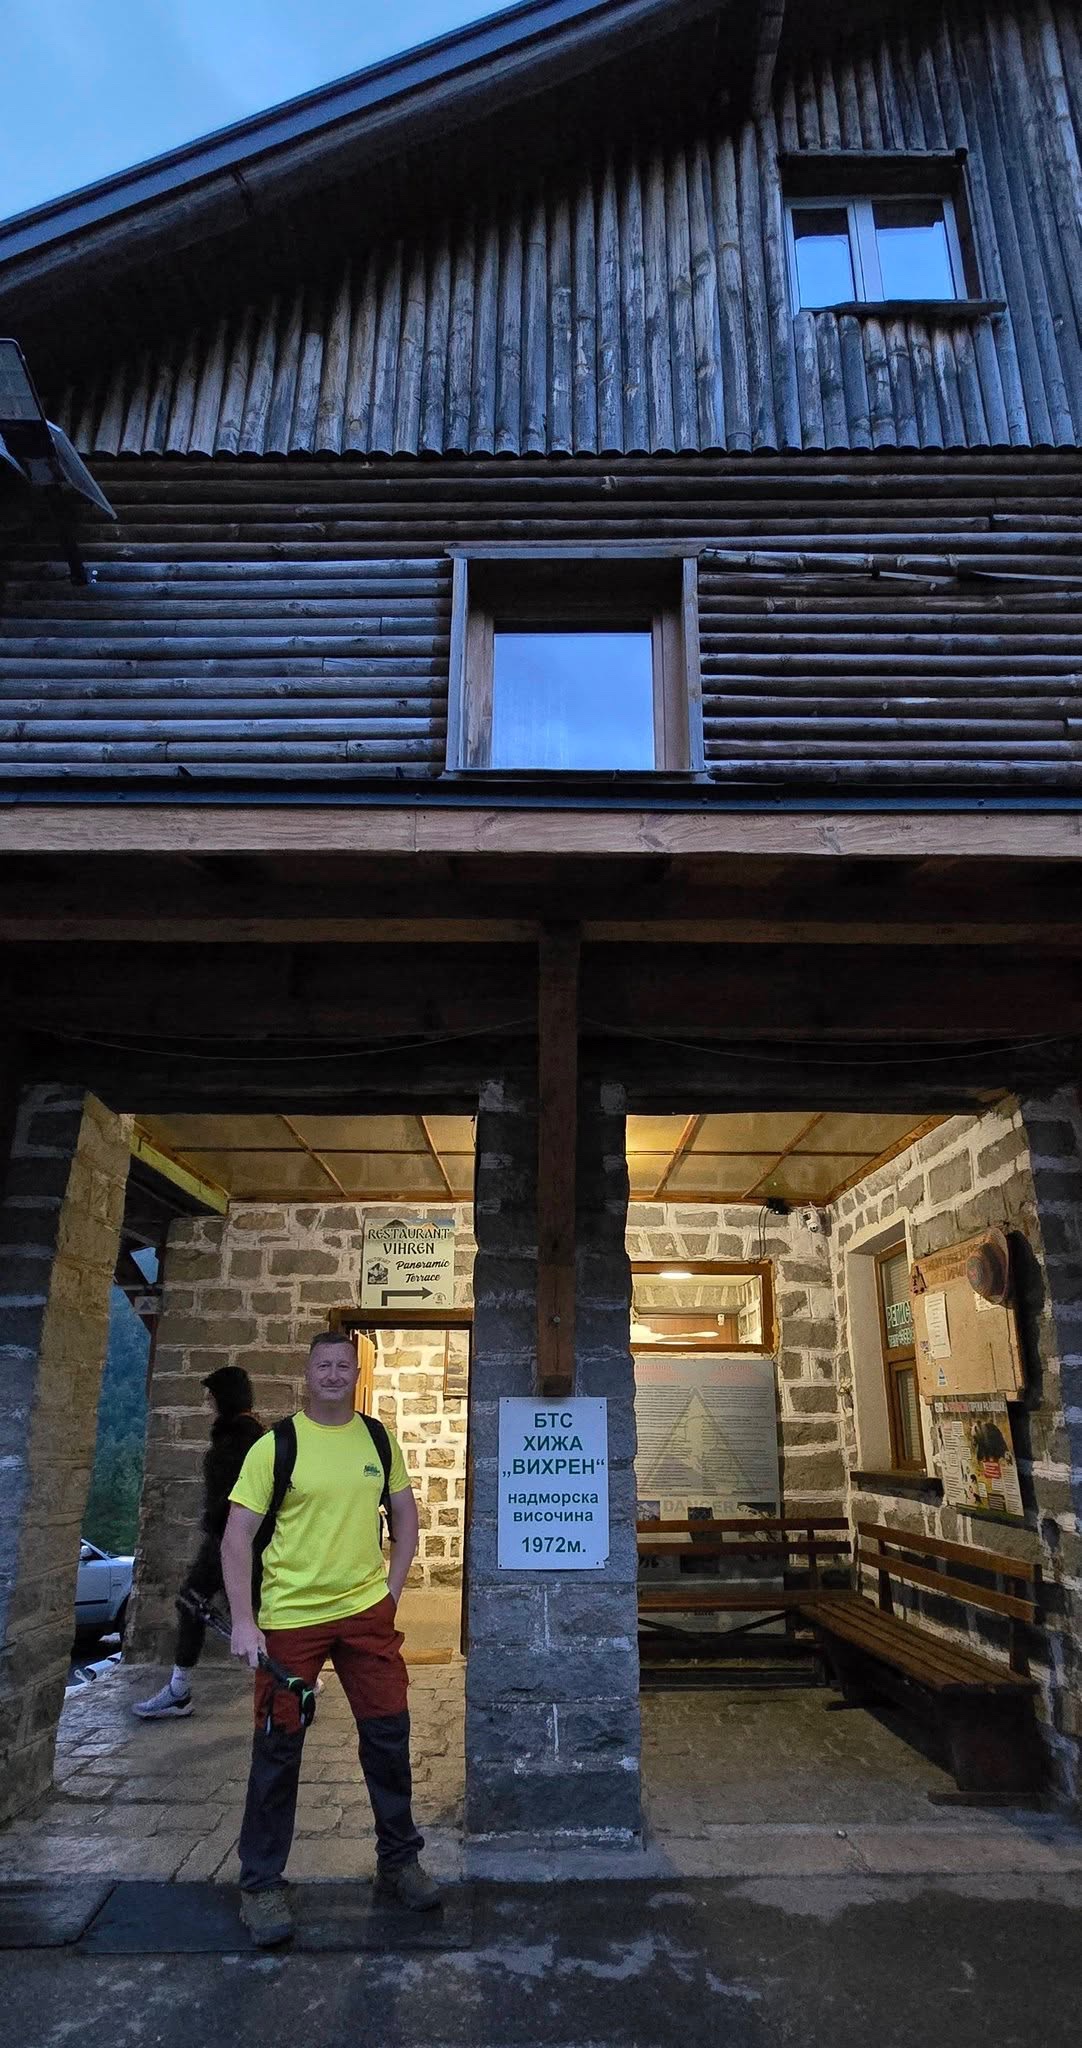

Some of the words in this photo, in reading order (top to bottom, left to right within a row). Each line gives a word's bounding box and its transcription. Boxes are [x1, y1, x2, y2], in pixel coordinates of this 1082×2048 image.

[368, 1228, 450, 1239] RESTAURANT
[383, 1242, 434, 1254] VIHREN
[396, 1259, 450, 1270] Panoramic
[405, 1273, 441, 1283] Terrace
[534, 1413, 573, 1428] БТС
[523, 1435, 583, 1451] ХИЖА
[502, 1458, 605, 1478] „ВИХРЕН“
[508, 1493, 598, 1506] надморска
[513, 1511, 593, 1522] височина
[521, 1536, 586, 1553] 1972м.
